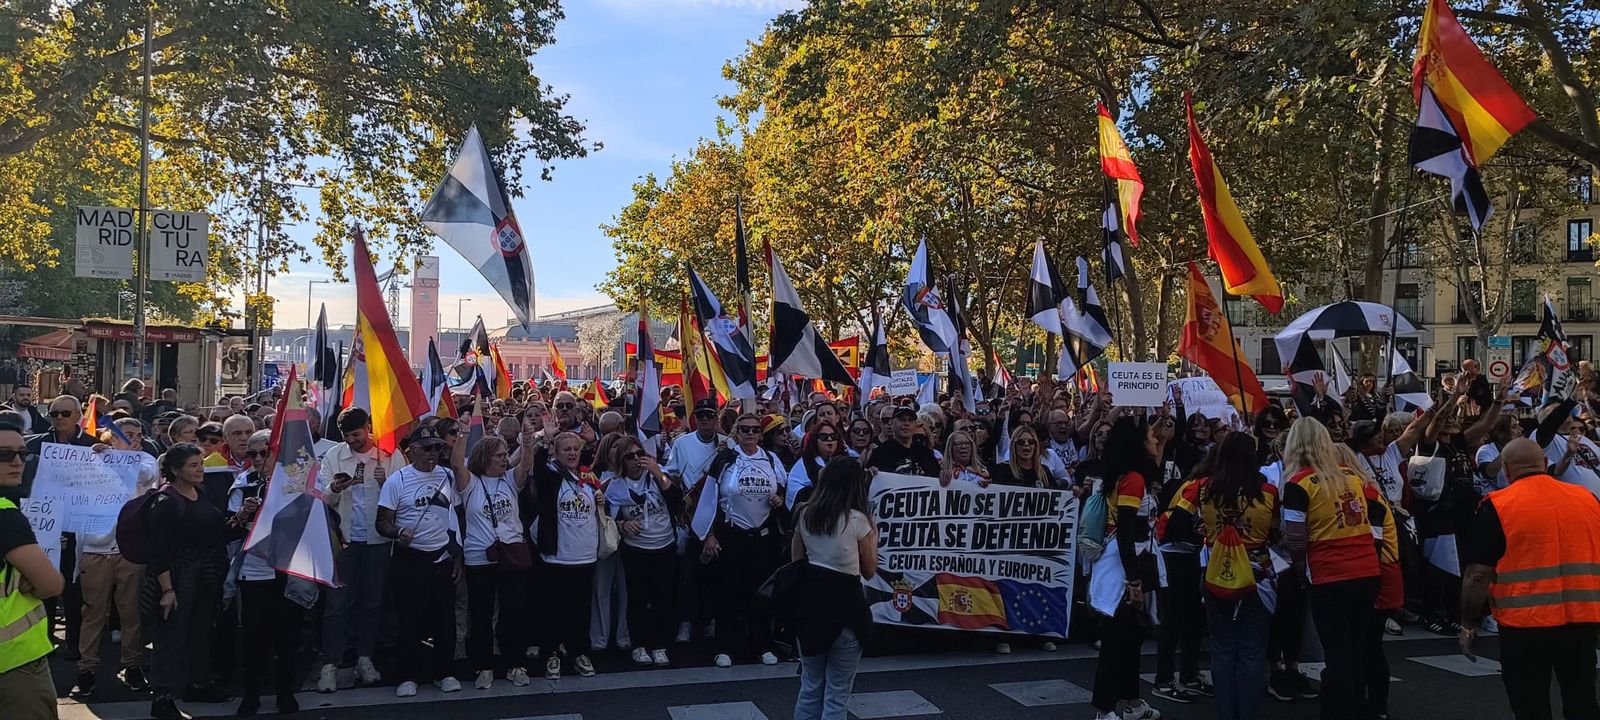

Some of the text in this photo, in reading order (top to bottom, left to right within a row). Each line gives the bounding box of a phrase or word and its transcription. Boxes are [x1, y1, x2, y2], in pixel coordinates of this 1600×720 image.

[79, 209, 132, 227] MAD
[154, 213, 197, 231] CUL
[99, 228, 132, 246] RID
[160, 231, 189, 248] TU
[78, 245, 104, 264] ES
[176, 250, 204, 267] RA
[1111, 371, 1139, 380] CEUTA
[1142, 372, 1153, 380] ES
[1118, 382, 1159, 390] PRINCIPIO
[44, 445, 77, 460] CEUTA
[80, 452, 97, 463] NO
[103, 453, 141, 465] OLVIDA
[879, 490, 940, 519] CEUTA
[973, 493, 996, 516] SE
[1000, 491, 1065, 521] VENDE,
[878, 522, 1073, 550] CEUTA SE DEFIENDE
[888, 554, 1052, 583] CEUTA ESPAÑOLA Y EUROPEA
